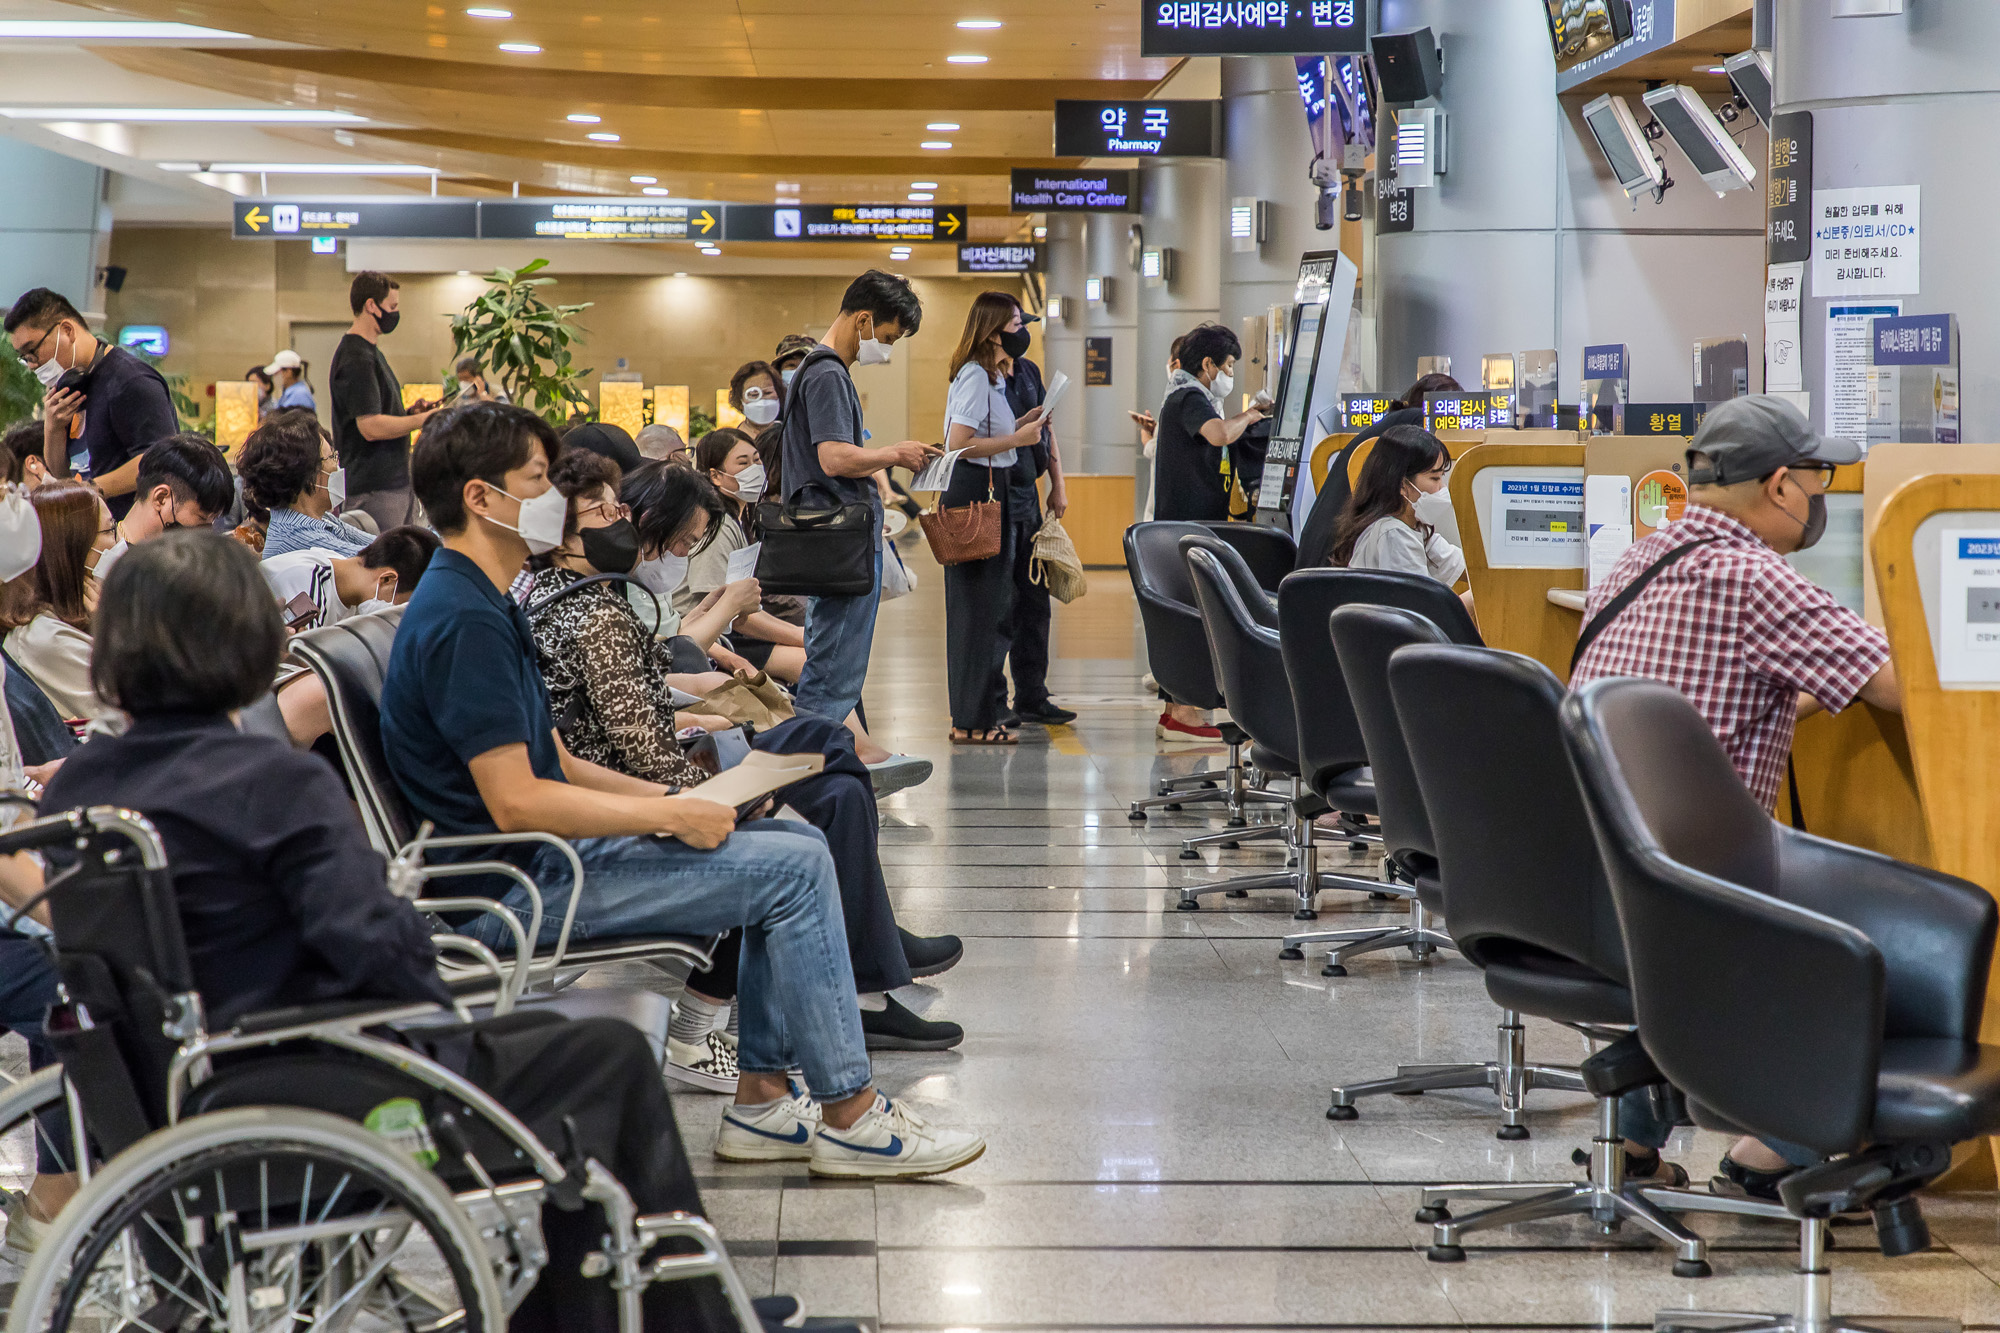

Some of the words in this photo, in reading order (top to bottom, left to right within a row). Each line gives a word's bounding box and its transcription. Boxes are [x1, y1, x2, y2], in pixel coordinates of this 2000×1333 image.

[1157, 1, 1288, 29] 외래검사예약
[1311, 0, 1354, 28] 변경
[1107, 137, 1161, 153] Pharmacy
[1035, 178, 1107, 190] International
[1014, 192, 1053, 204] Health
[1055, 192, 1084, 205] Care
[1086, 192, 1127, 206] Center
[1390, 199, 1408, 221] 변경
[1825, 205, 1848, 218] 원활한
[1852, 204, 1879, 217] 업무를
[1884, 203, 1904, 215] 위해
[1774, 219, 1797, 243] 주세요.
[1825, 249, 1841, 260] 미리
[1844, 247, 1903, 260] 준비해주세요.
[1837, 267, 1886, 280] 감사합니다.
[1920, 327, 1931, 352] 가입
[1434, 400, 1486, 415] 외래검사
[1350, 413, 1387, 428] 예약변
[1434, 416, 1486, 430] 예약변경
[1650, 413, 1681, 431] 황열
